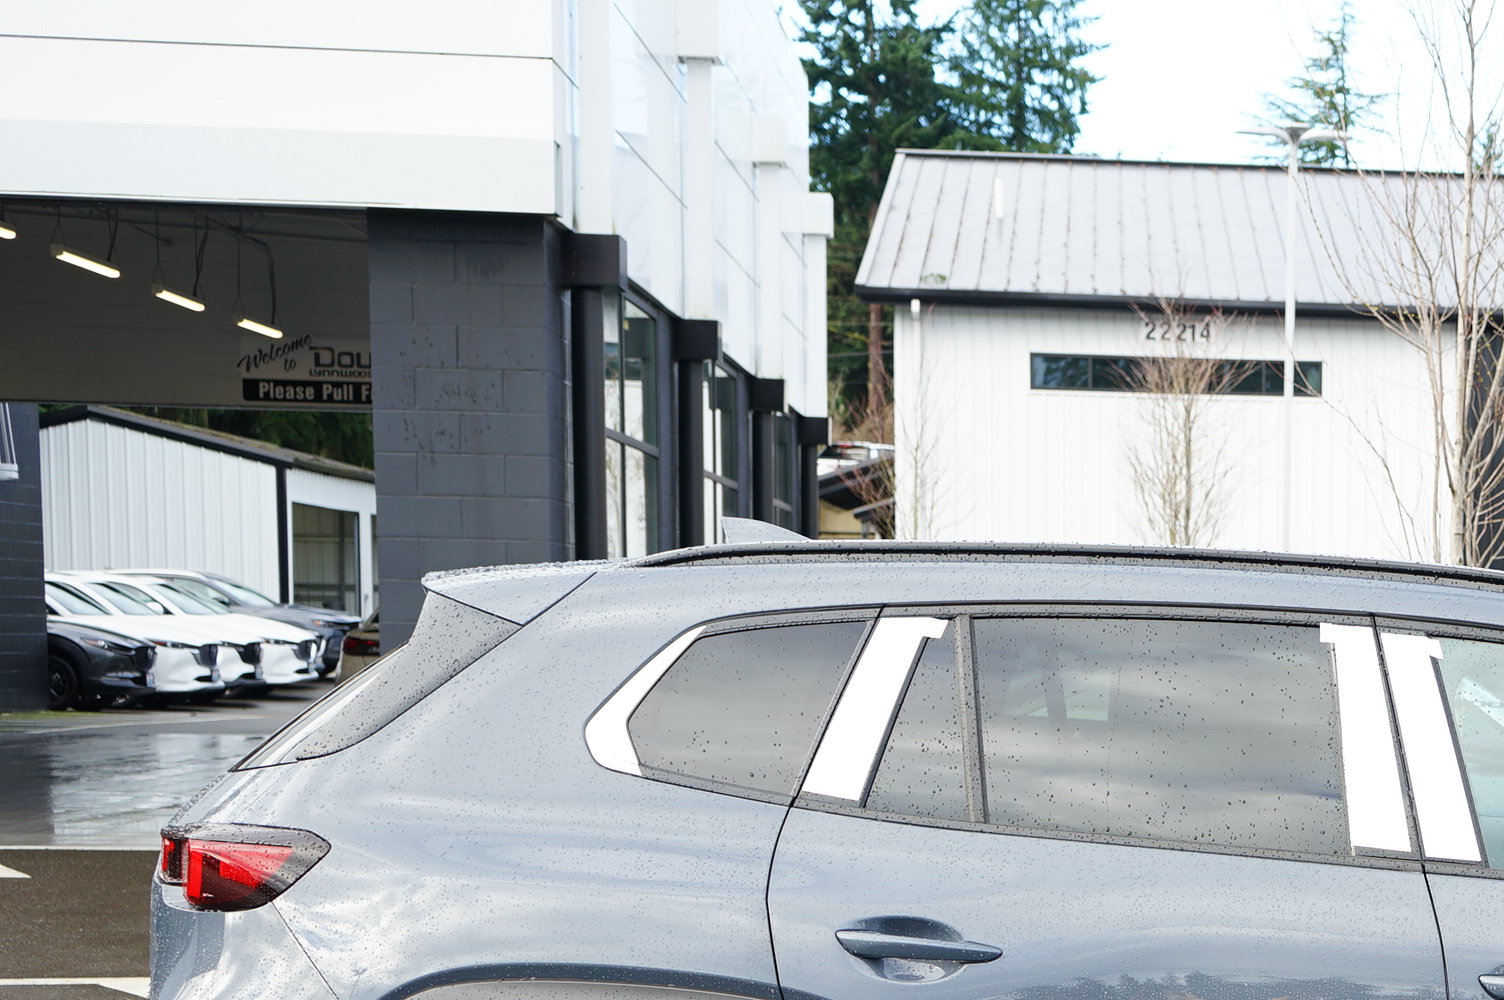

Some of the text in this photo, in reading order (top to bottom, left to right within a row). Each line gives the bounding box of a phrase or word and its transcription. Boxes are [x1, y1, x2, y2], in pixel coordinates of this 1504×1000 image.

[1145, 321, 1210, 341] 22214
[236, 334, 312, 372] Welcome
[284, 357, 297, 372] to
[259, 380, 314, 400] Please
[322, 382, 353, 401] Pull
